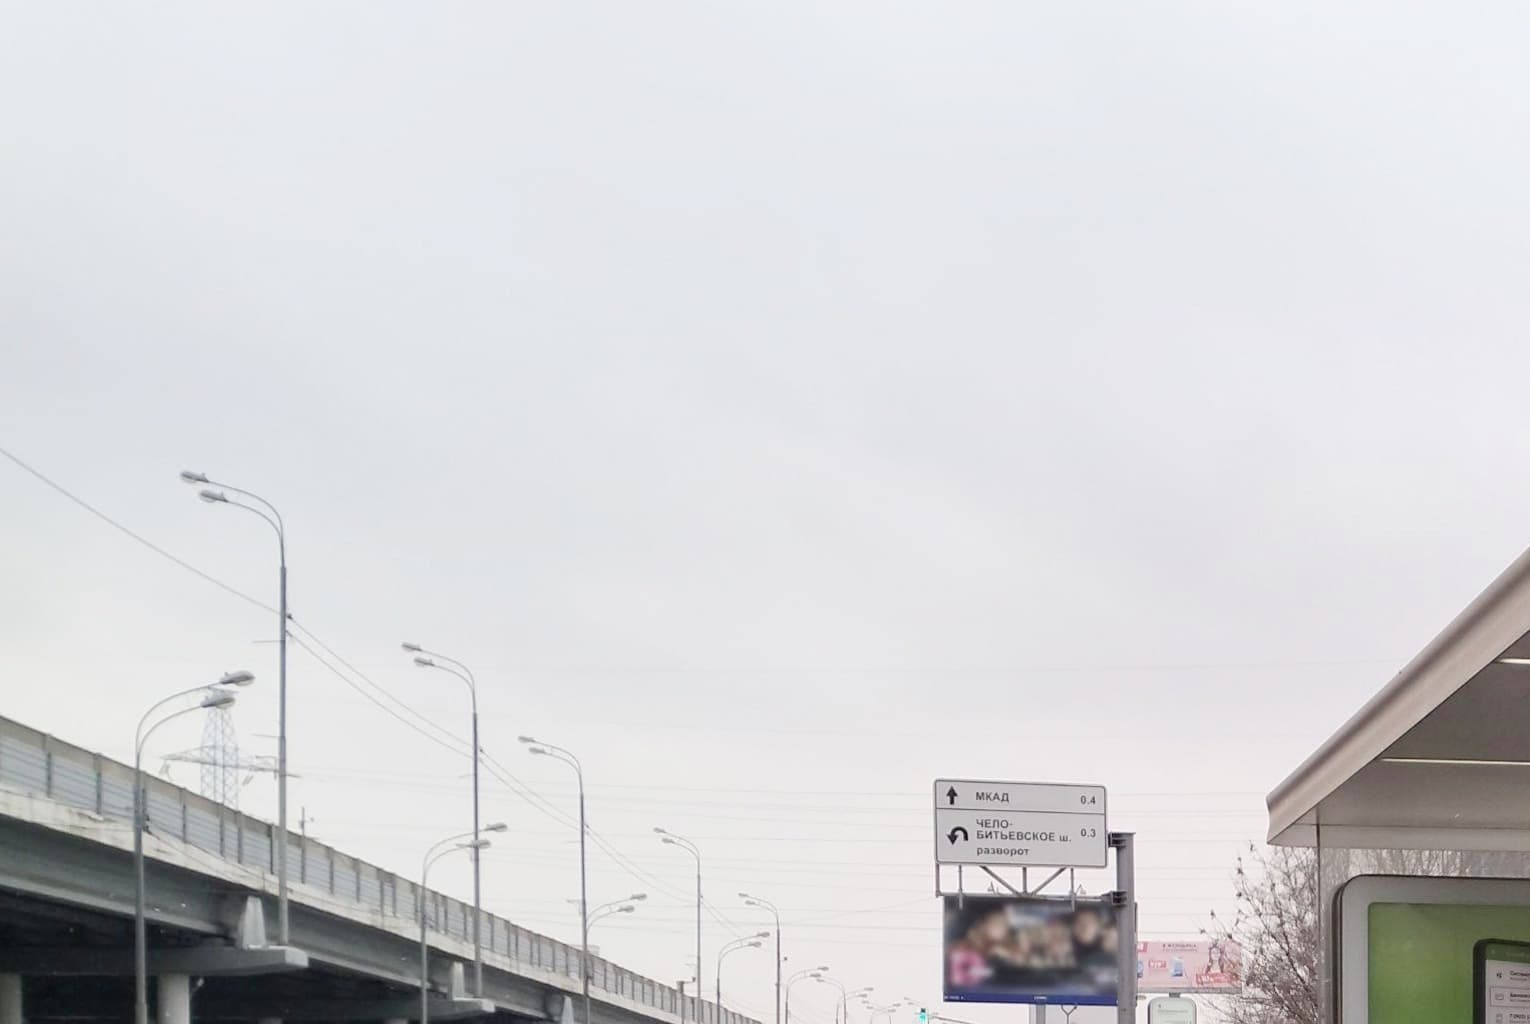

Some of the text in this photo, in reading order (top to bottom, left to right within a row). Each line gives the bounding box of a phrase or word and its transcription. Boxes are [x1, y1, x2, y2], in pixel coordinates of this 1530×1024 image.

[975, 791, 1096, 805] МКАД 0.4
[976, 818, 1013, 829] ЧЕЛО-
[976, 830, 1072, 843] БИТЬЕВСКОЕ ш.
[1080, 828, 1097, 838] 0.3
[976, 846, 1030, 857] разворот
